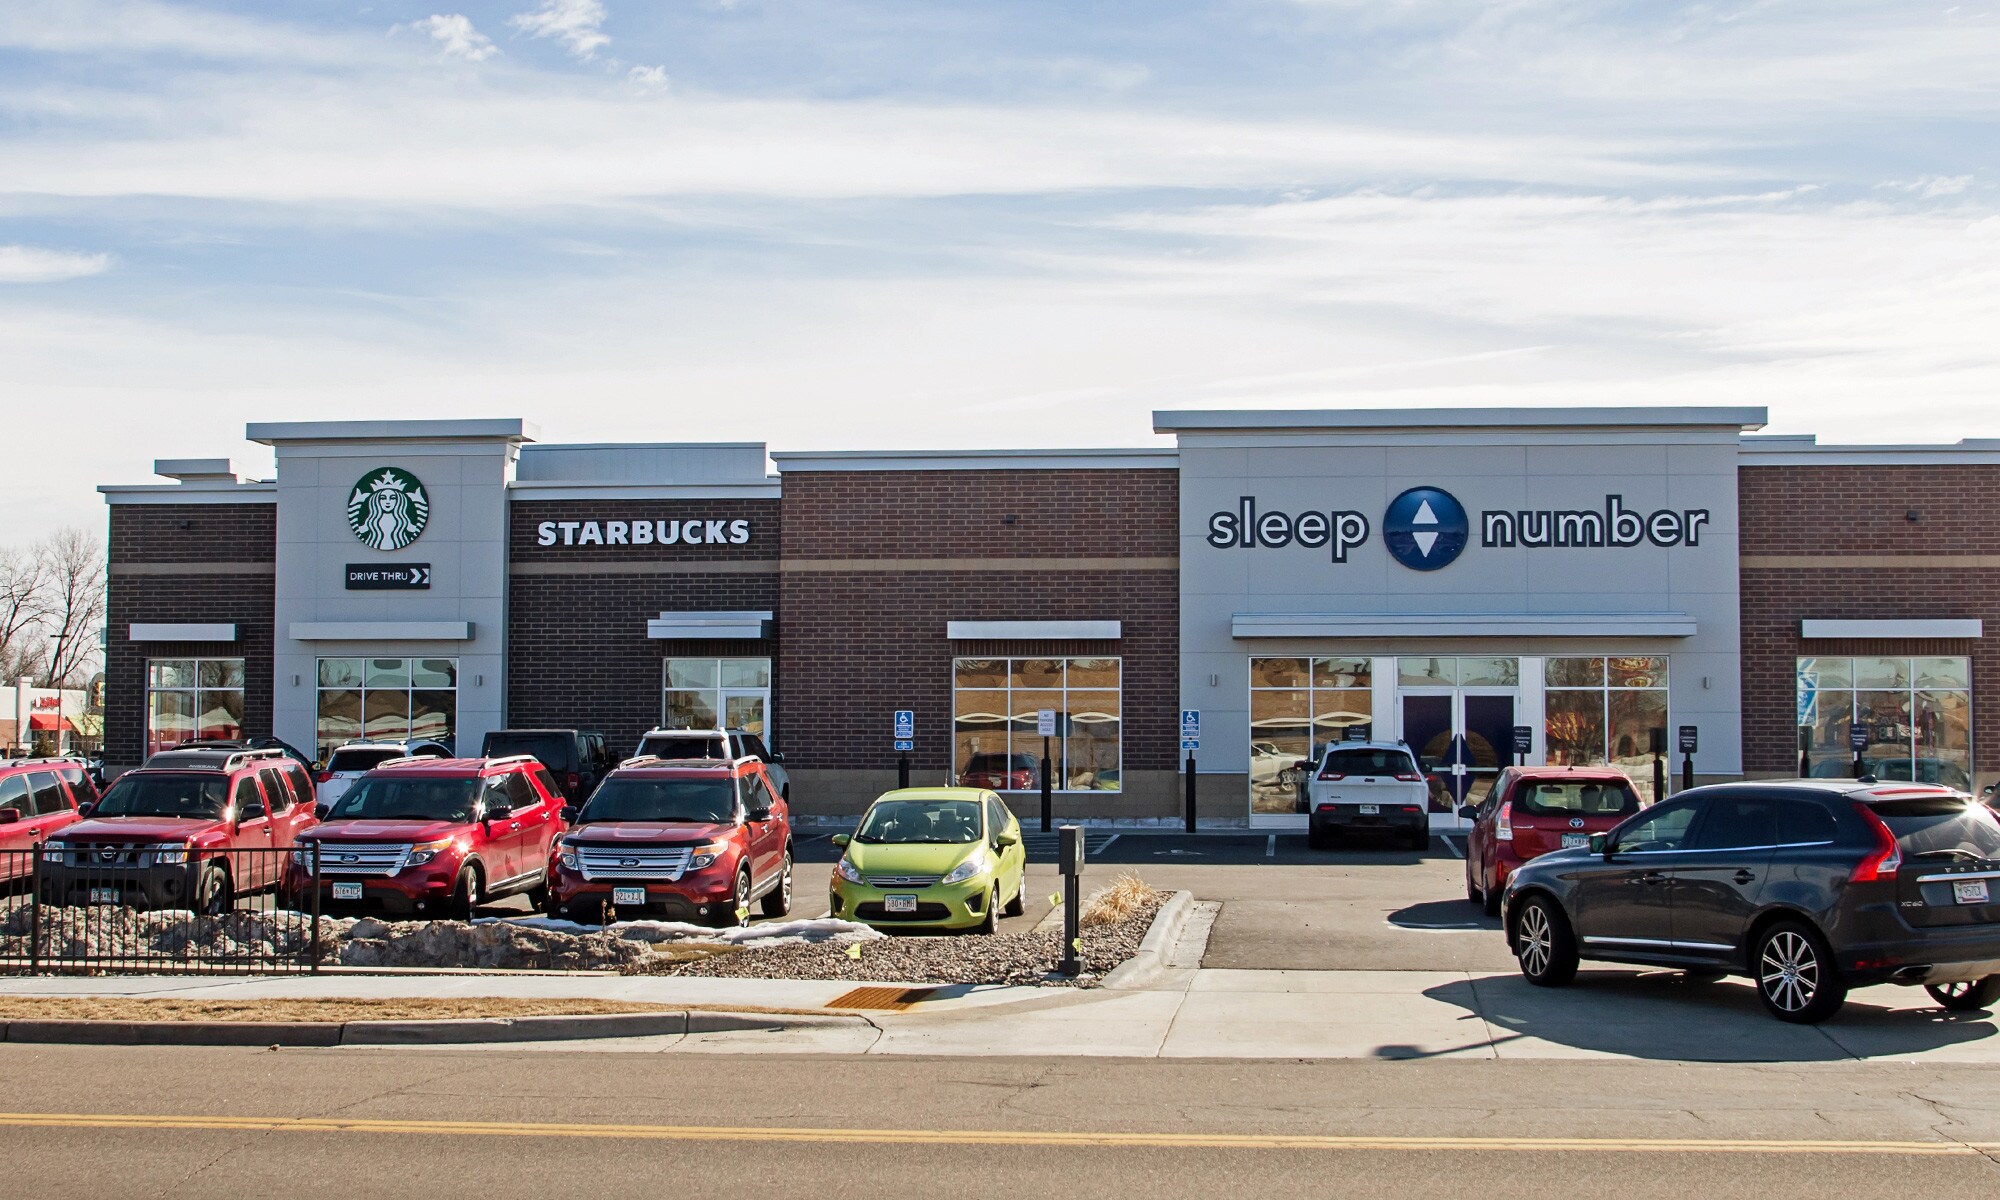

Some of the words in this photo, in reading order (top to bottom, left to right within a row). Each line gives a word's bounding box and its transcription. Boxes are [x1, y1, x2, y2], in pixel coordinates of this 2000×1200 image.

[537, 519, 750, 546] STARBUCKS
[1206, 496, 1369, 563] sleep
[1482, 494, 1709, 548] number
[350, 572, 379, 581] DRIVE
[381, 571, 408, 581] THRU
[1944, 864, 2000, 873] VOLV
